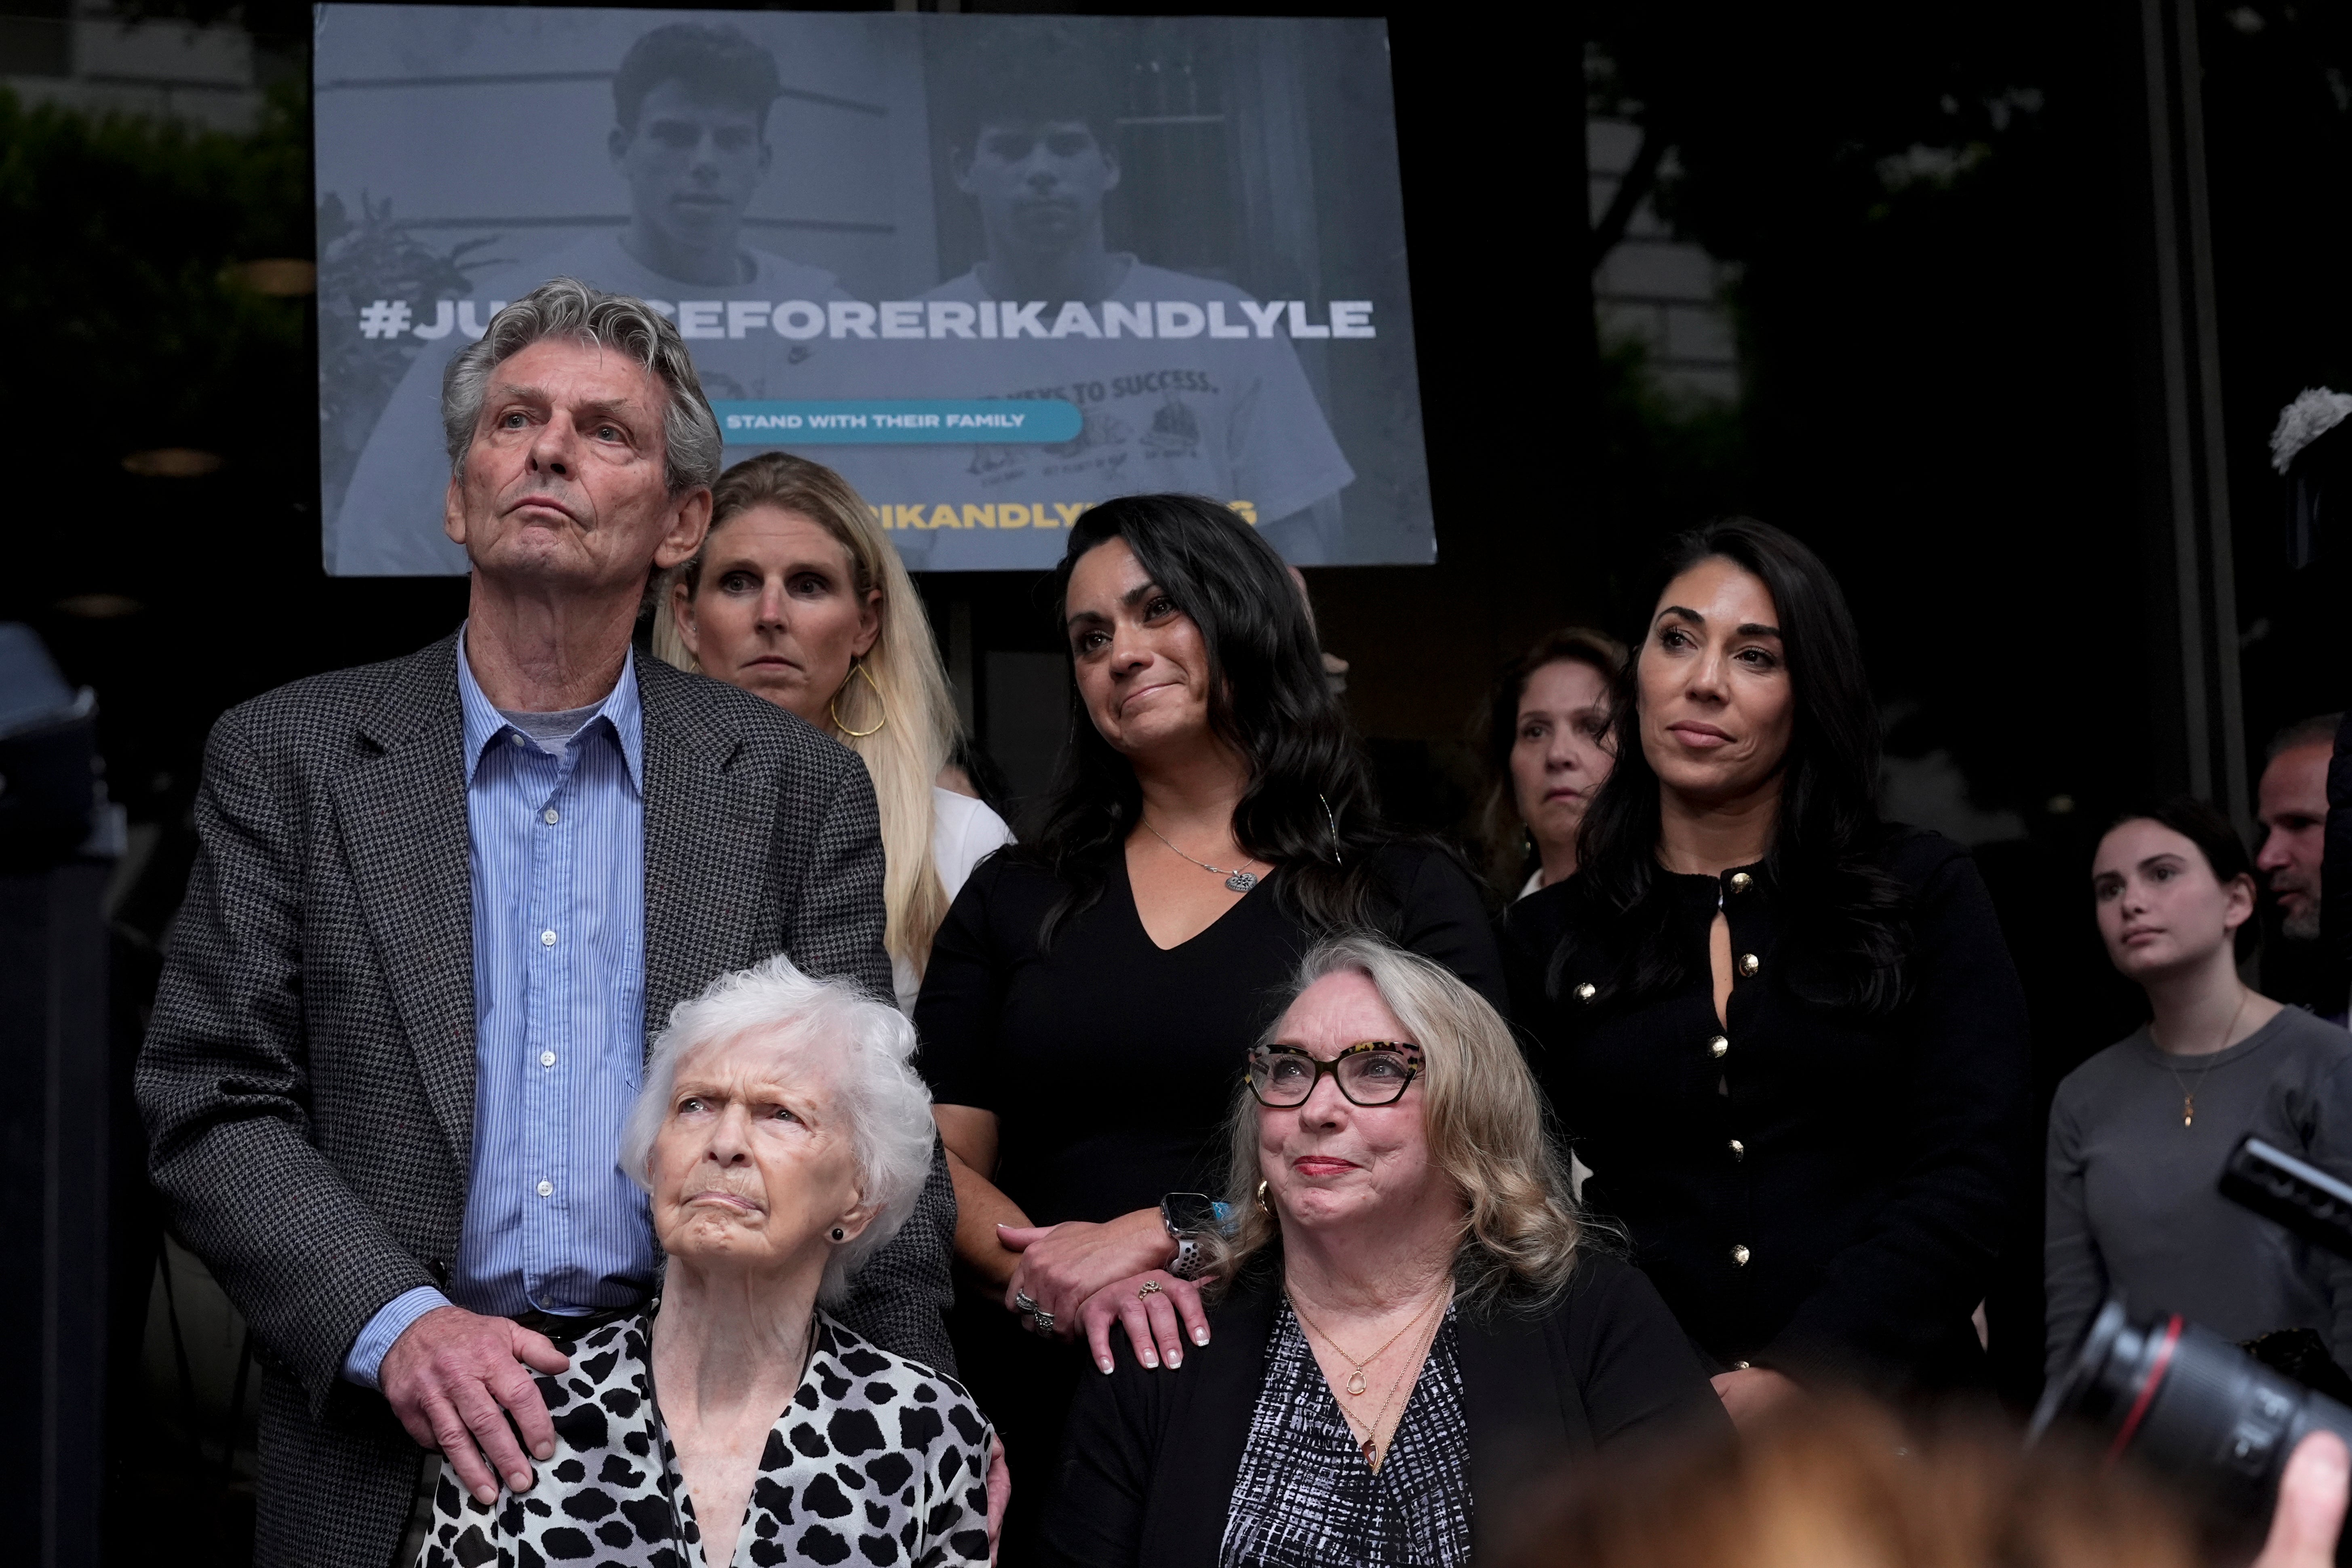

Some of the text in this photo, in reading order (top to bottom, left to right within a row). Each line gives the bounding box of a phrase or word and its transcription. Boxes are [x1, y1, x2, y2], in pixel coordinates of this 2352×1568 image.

[359, 299, 1376, 340] #JUEFORERIKANDLYLE
[1073, 381, 1105, 405] TO
[728, 414, 1025, 428] STAND WITH THEIR FAMILY
